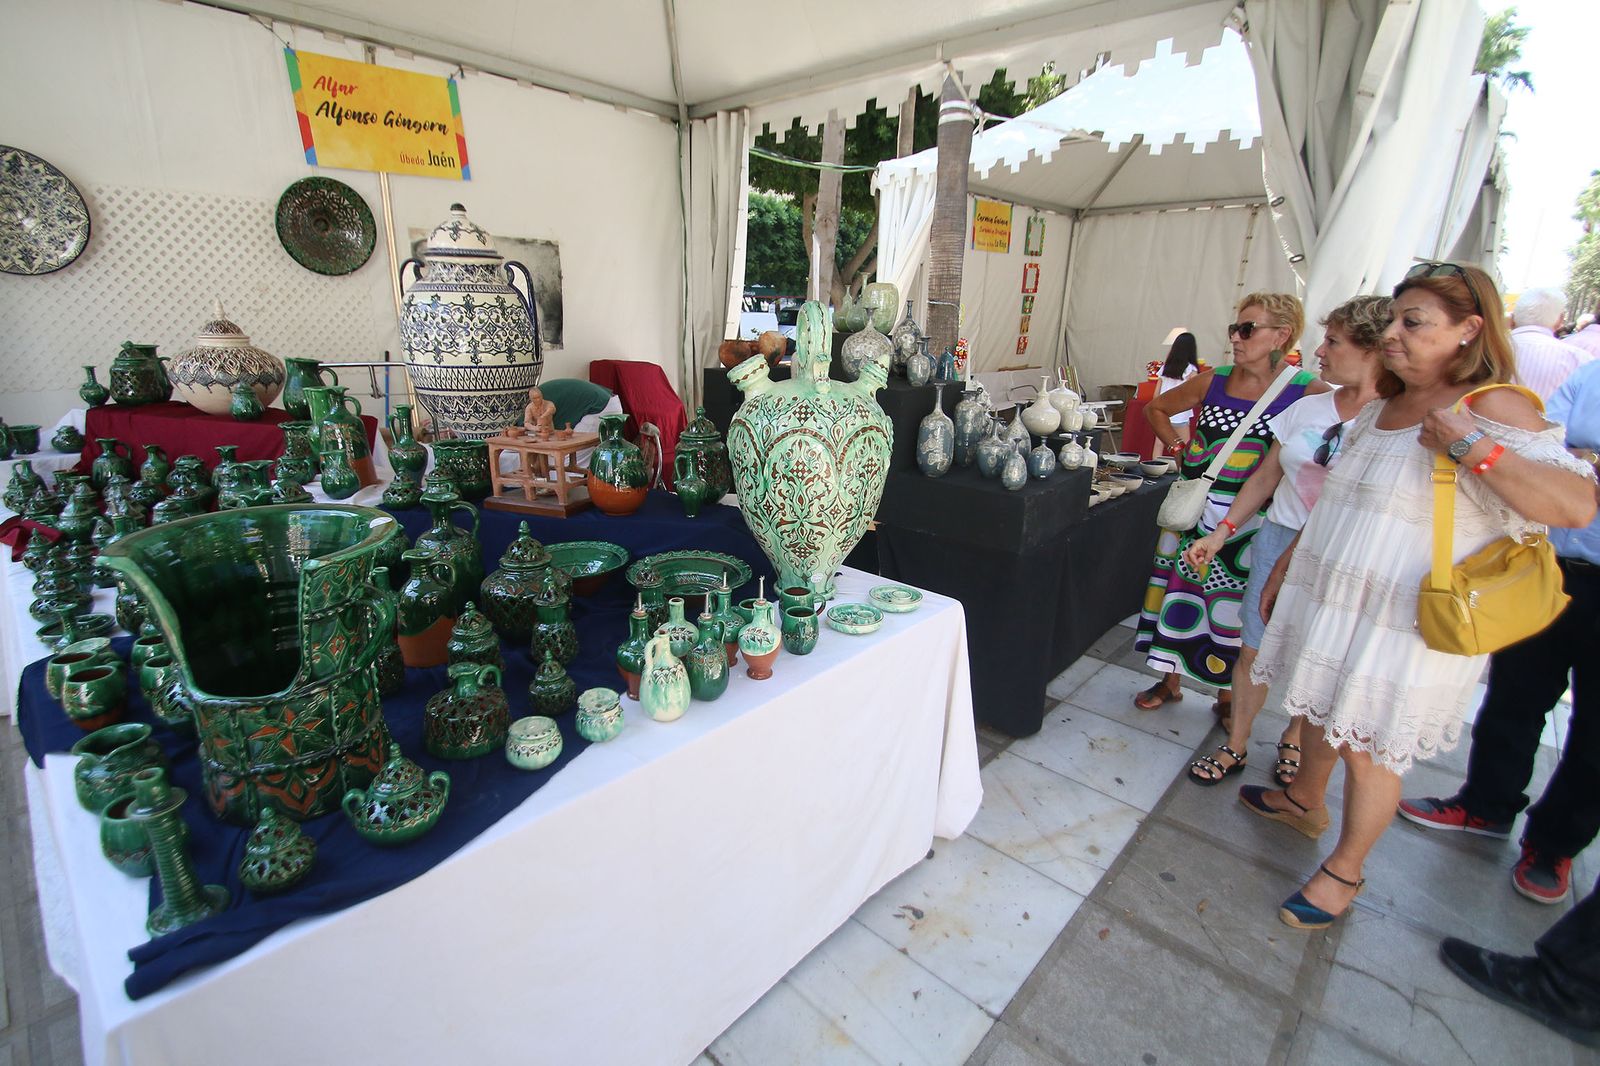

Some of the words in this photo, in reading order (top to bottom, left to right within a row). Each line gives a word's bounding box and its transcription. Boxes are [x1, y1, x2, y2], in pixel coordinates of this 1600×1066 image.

[313, 75, 359, 97] Alfar
[315, 100, 378, 126] Alfonso
[383, 110, 449, 135] Góngora
[399, 151, 425, 165] Úbeda
[427, 149, 456, 168] Jaén
